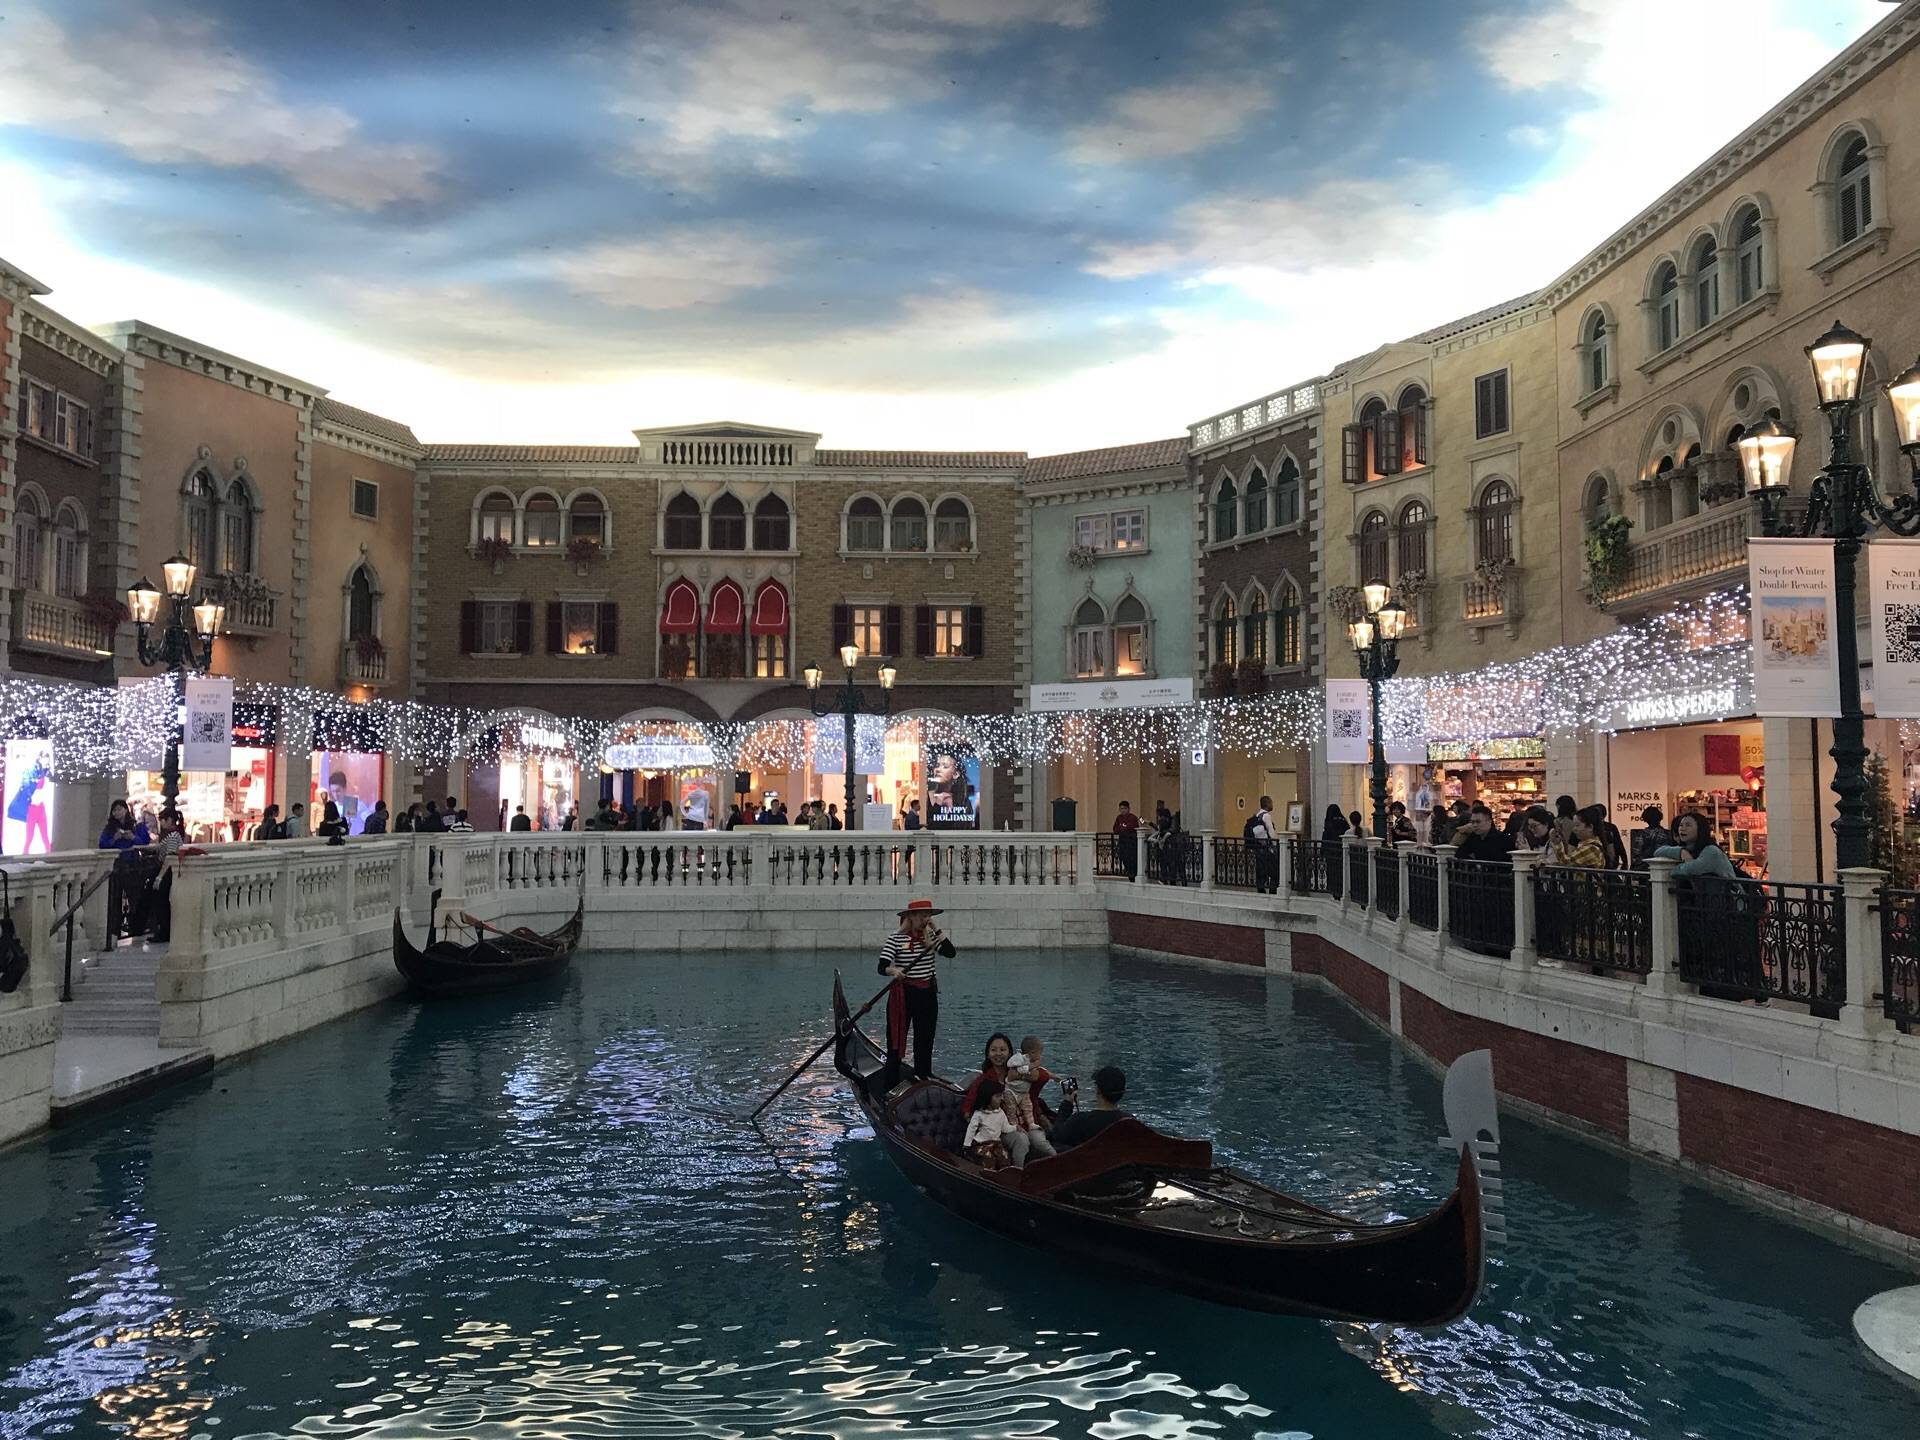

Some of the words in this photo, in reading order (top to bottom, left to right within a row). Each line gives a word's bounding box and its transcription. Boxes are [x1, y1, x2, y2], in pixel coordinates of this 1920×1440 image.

[1759, 565, 1780, 577] Shop
[1782, 565, 1794, 575] for
[1795, 565, 1826, 575] Winter
[1891, 568, 1916, 577] Scan
[1759, 580, 1789, 589] Double
[1791, 580, 1827, 589] Rewards
[1886, 580, 1908, 590] Free
[1618, 791, 1651, 801] MARKS
[1653, 792, 1660, 801] &
[940, 806, 968, 814] HAPPY
[1616, 803, 1663, 812] SPENCR
[933, 814, 975, 822] HOLIDAYS!
